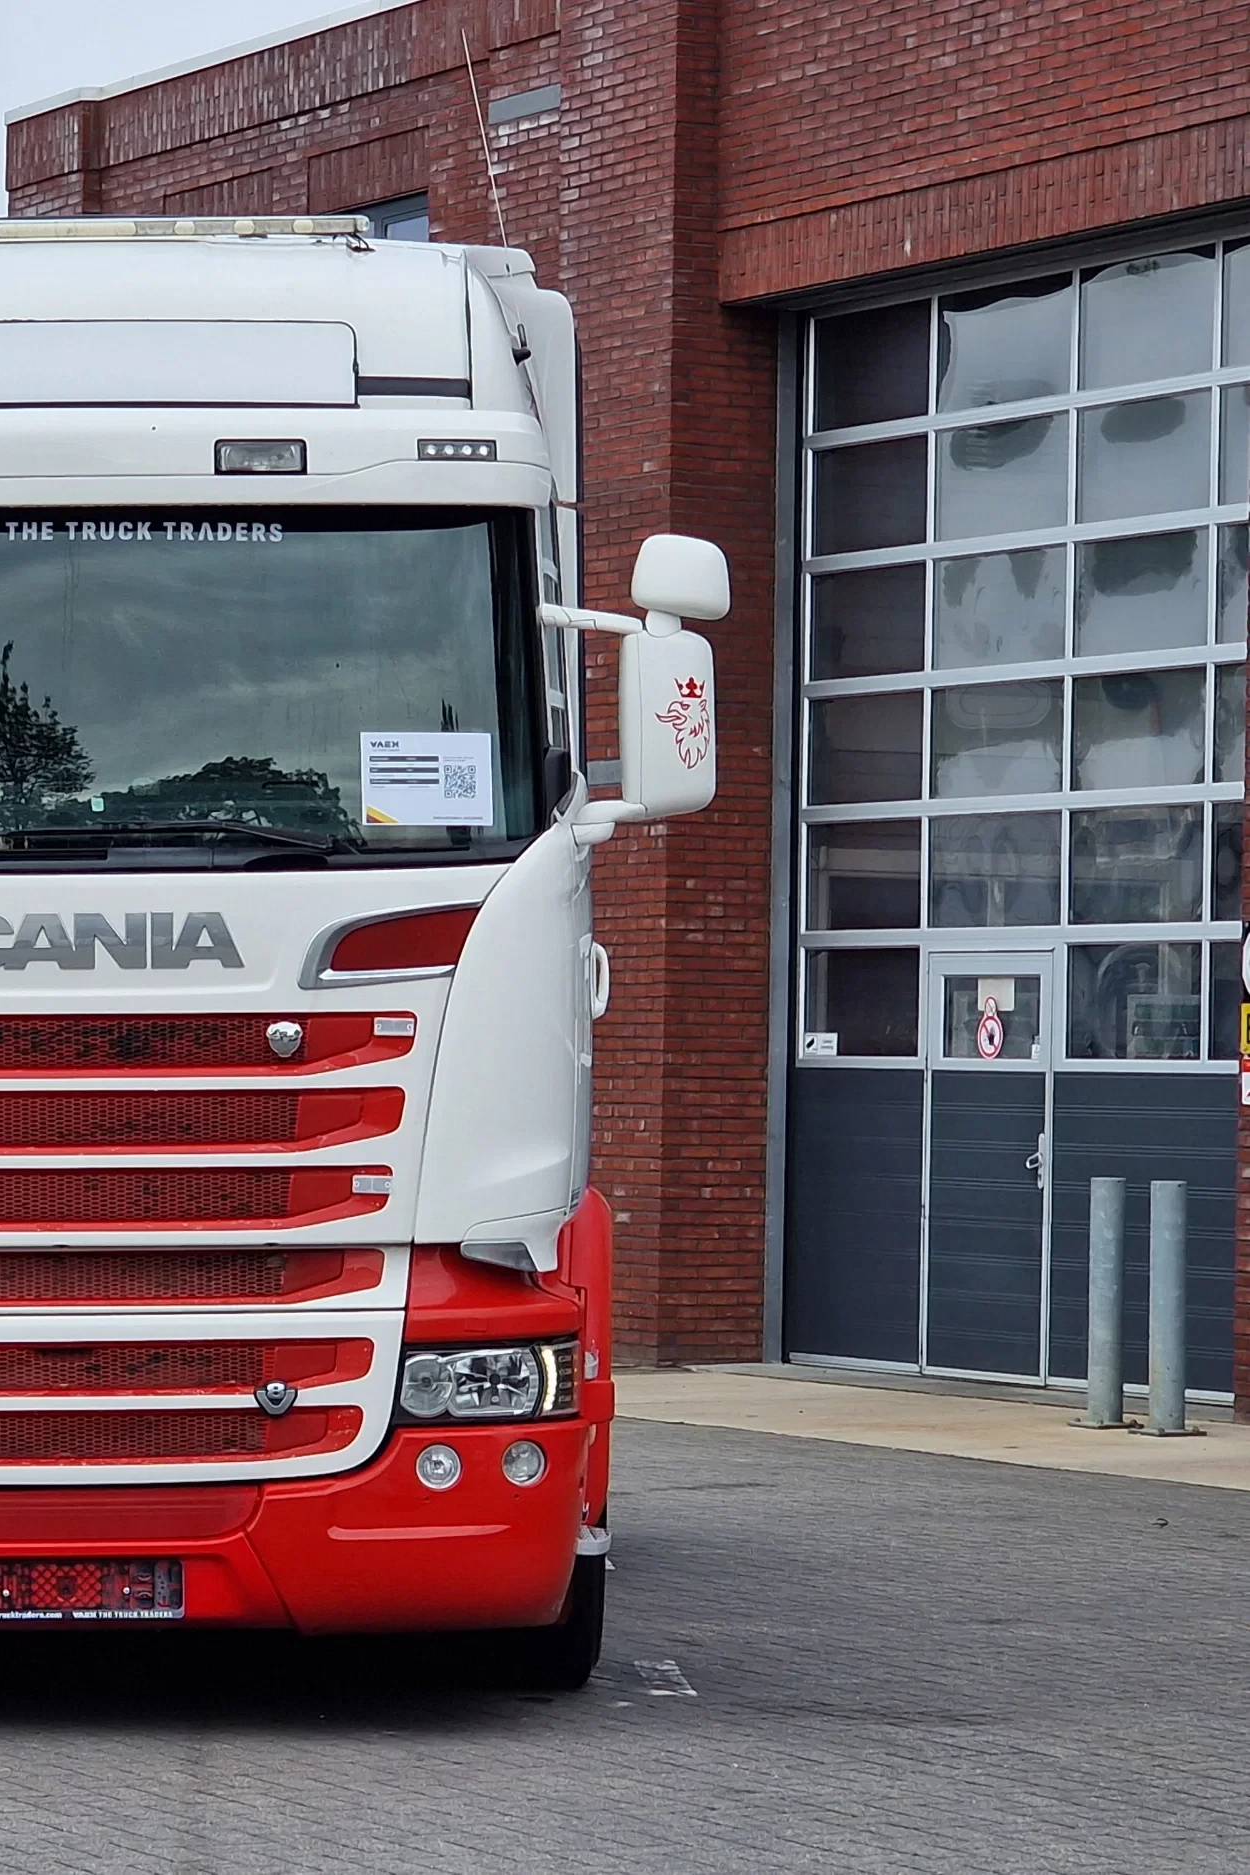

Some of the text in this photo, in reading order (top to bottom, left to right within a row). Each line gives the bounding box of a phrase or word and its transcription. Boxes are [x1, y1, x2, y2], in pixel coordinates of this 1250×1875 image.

[5, 521, 54, 542] THE
[66, 521, 152, 542] TRUCK
[163, 521, 283, 543] TRADERS
